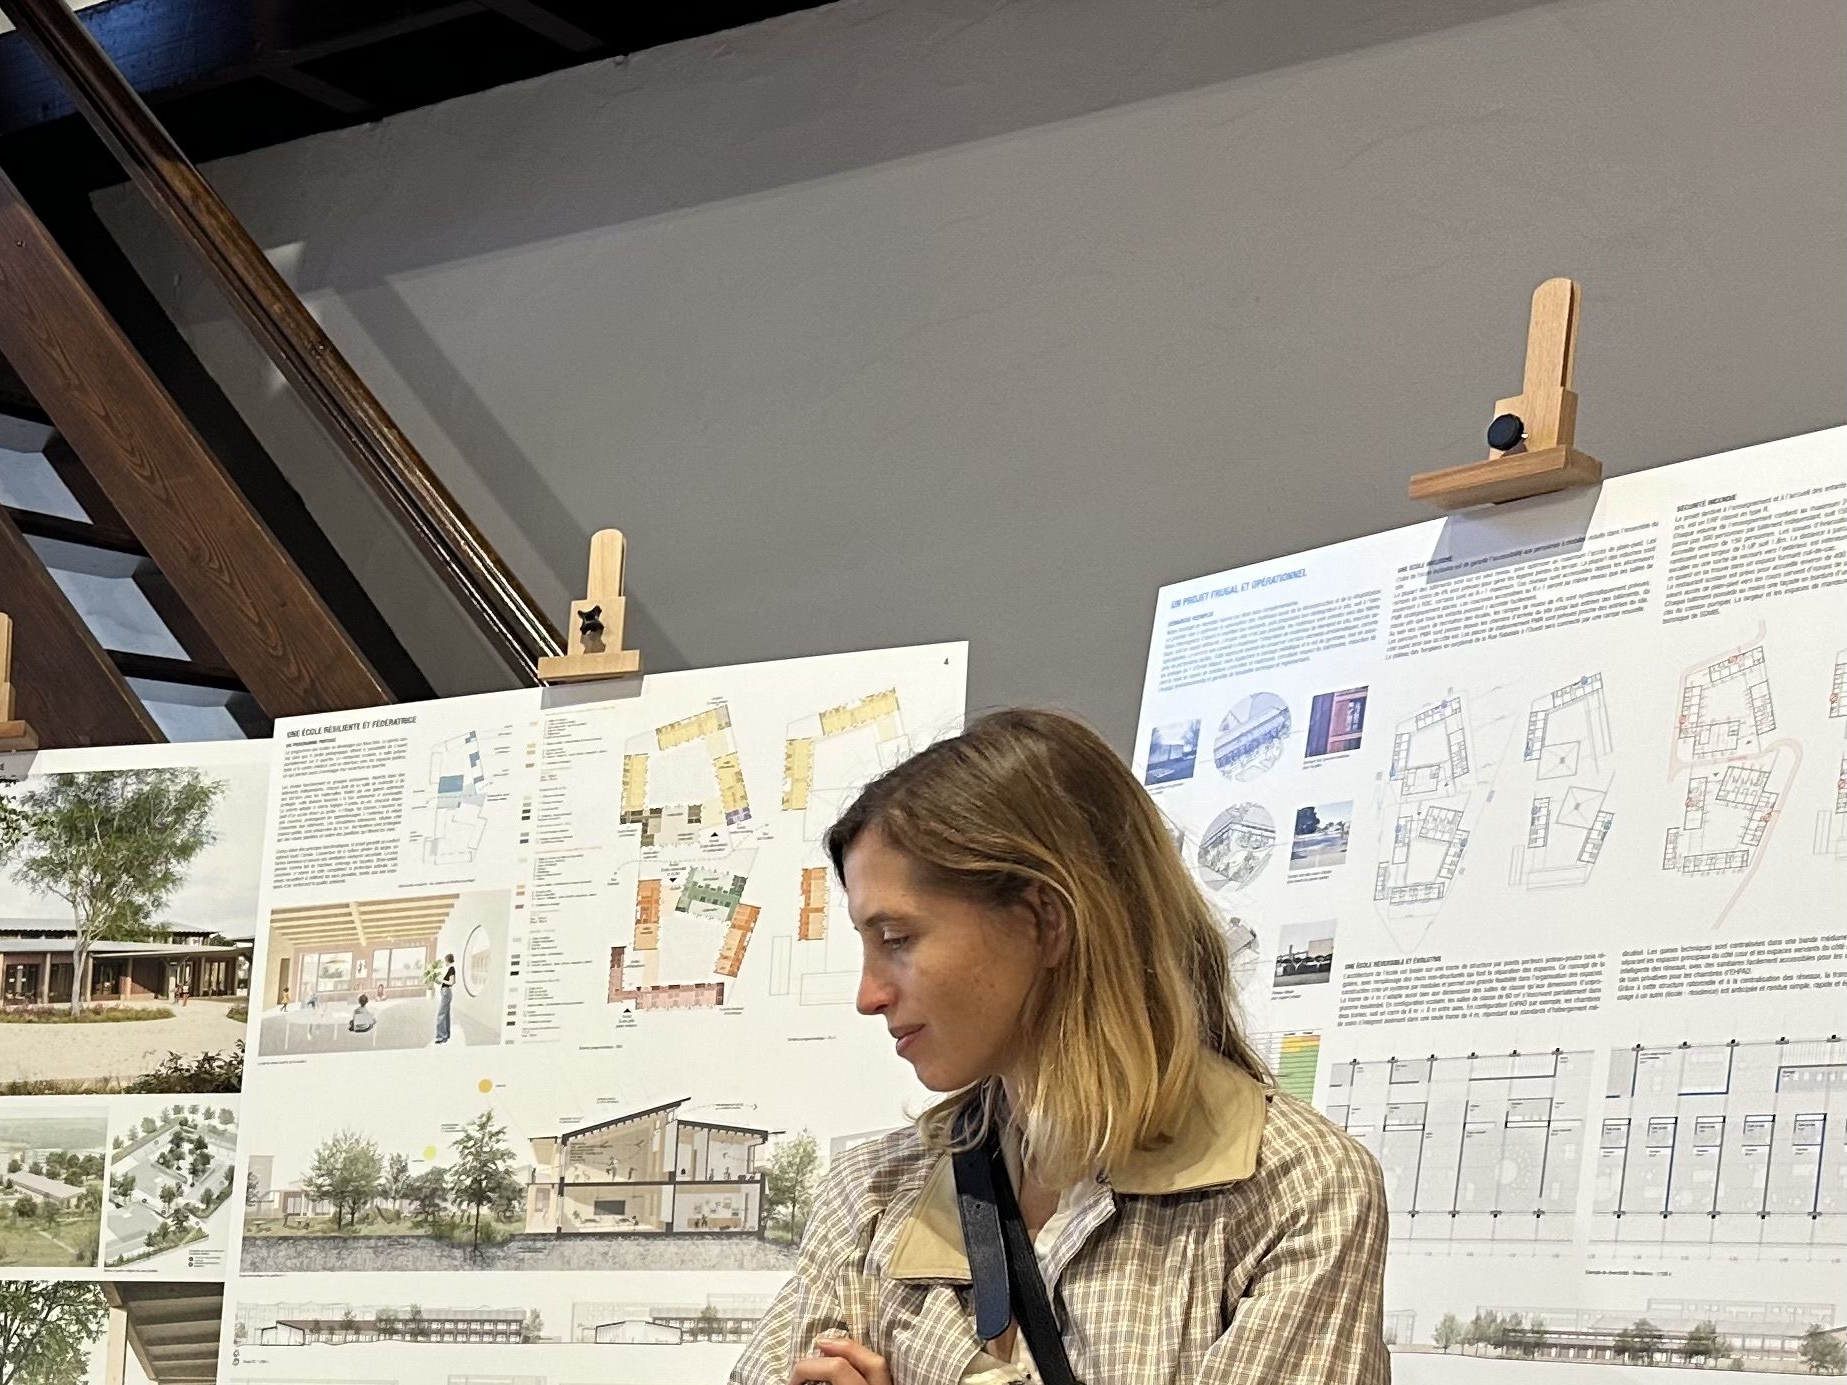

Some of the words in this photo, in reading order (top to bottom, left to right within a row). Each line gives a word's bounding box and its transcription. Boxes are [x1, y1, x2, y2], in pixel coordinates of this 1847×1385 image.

[1170, 598, 1182, 609] UN
[1182, 592, 1209, 606] PROJET
[1211, 586, 1238, 599] FRUGAL
[1240, 582, 1250, 592] ET
[1252, 568, 1307, 590] OPÉRATIONNEL
[302, 726, 322, 736] ÉCOLE
[324, 723, 360, 734] RÉSILIENTE
[362, 721, 370, 729] ET
[372, 716, 417, 728] FÉDÉRATRICE
